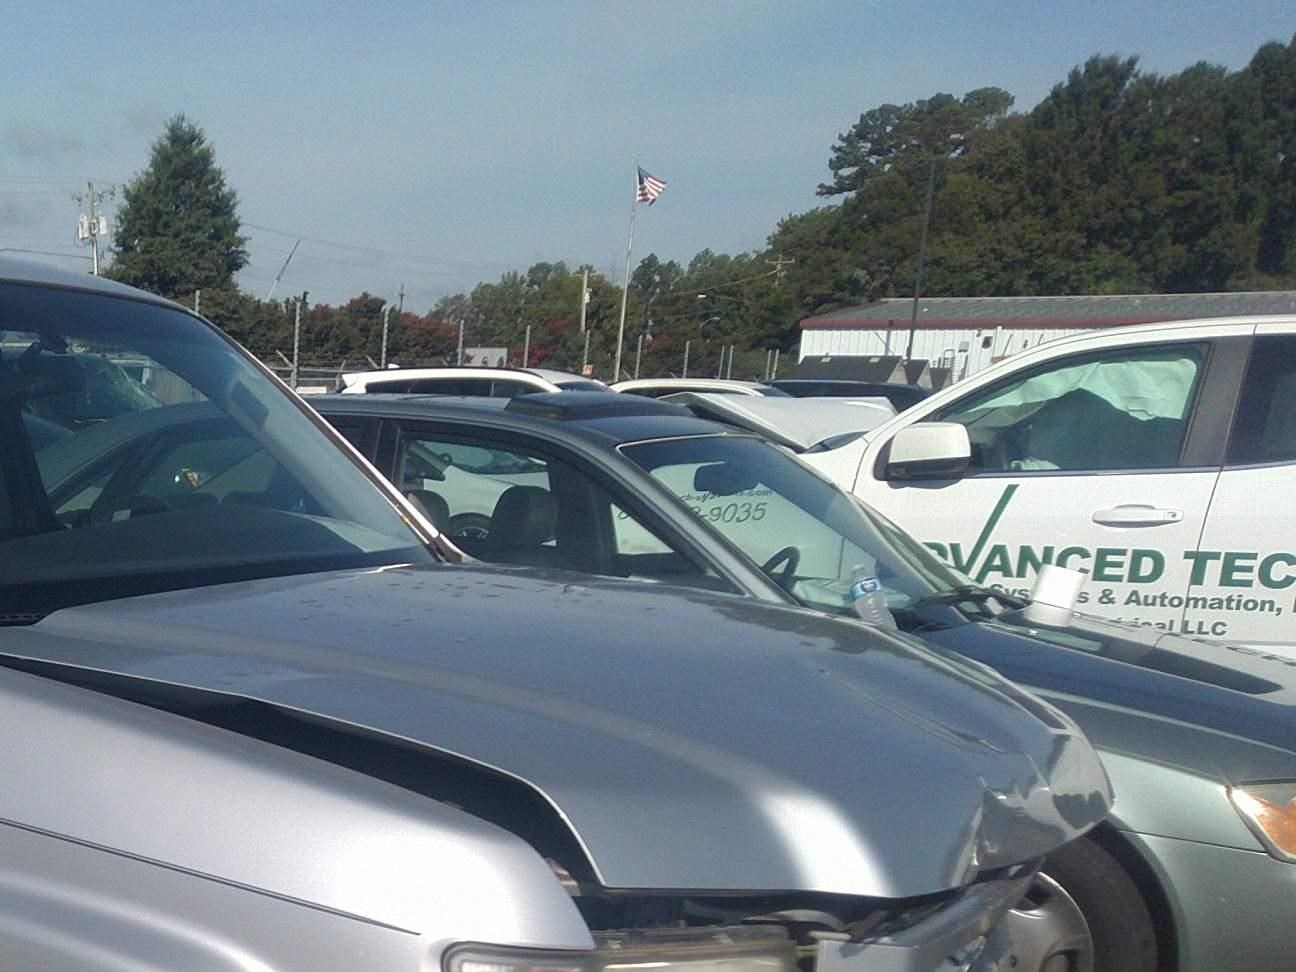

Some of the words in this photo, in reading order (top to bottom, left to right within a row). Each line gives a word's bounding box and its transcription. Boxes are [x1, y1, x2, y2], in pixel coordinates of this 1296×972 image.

[1097, 588, 1116, 605] &
[1124, 589, 1282, 616] Automation,
[1181, 619, 1227, 636] LLC
